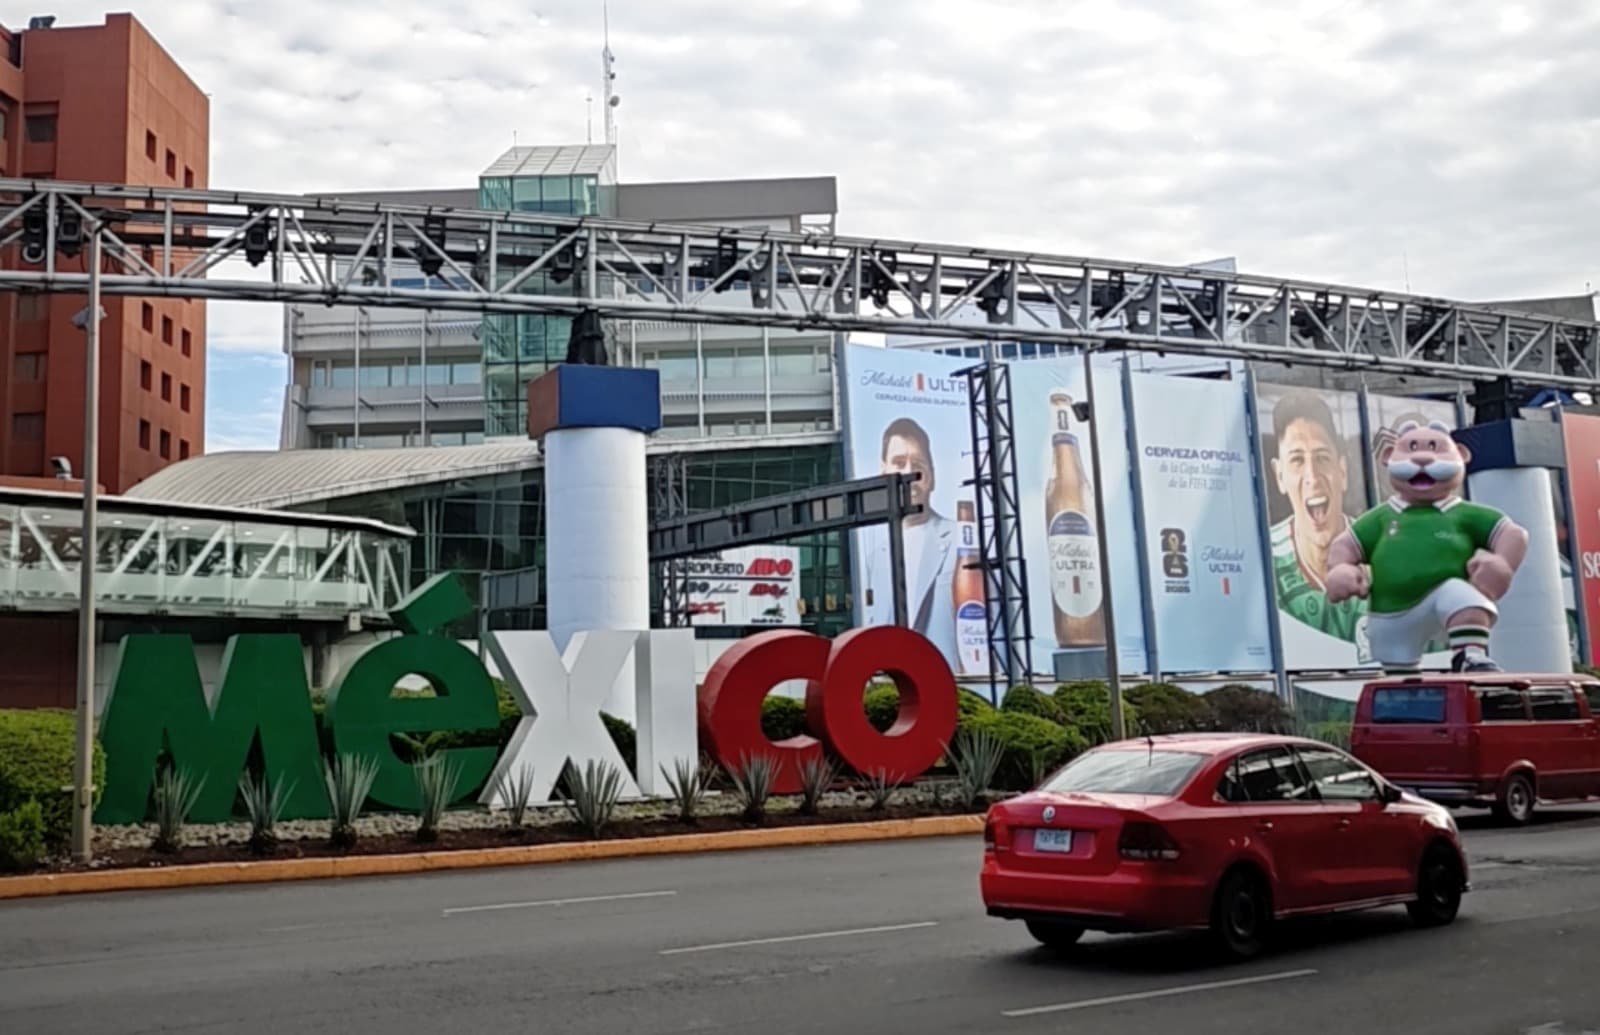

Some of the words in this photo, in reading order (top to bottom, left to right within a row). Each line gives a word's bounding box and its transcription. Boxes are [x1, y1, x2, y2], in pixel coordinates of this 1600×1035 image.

[928, 378, 967, 393] ULTR
[1145, 446, 1199, 459] CERVEZA
[1200, 450, 1244, 463] OFICIAL
[1180, 463, 1199, 476] Copa
[745, 558, 793, 576] ADO
[1056, 560, 1095, 571] ULTRA
[1209, 563, 1242, 573] ULTRA
